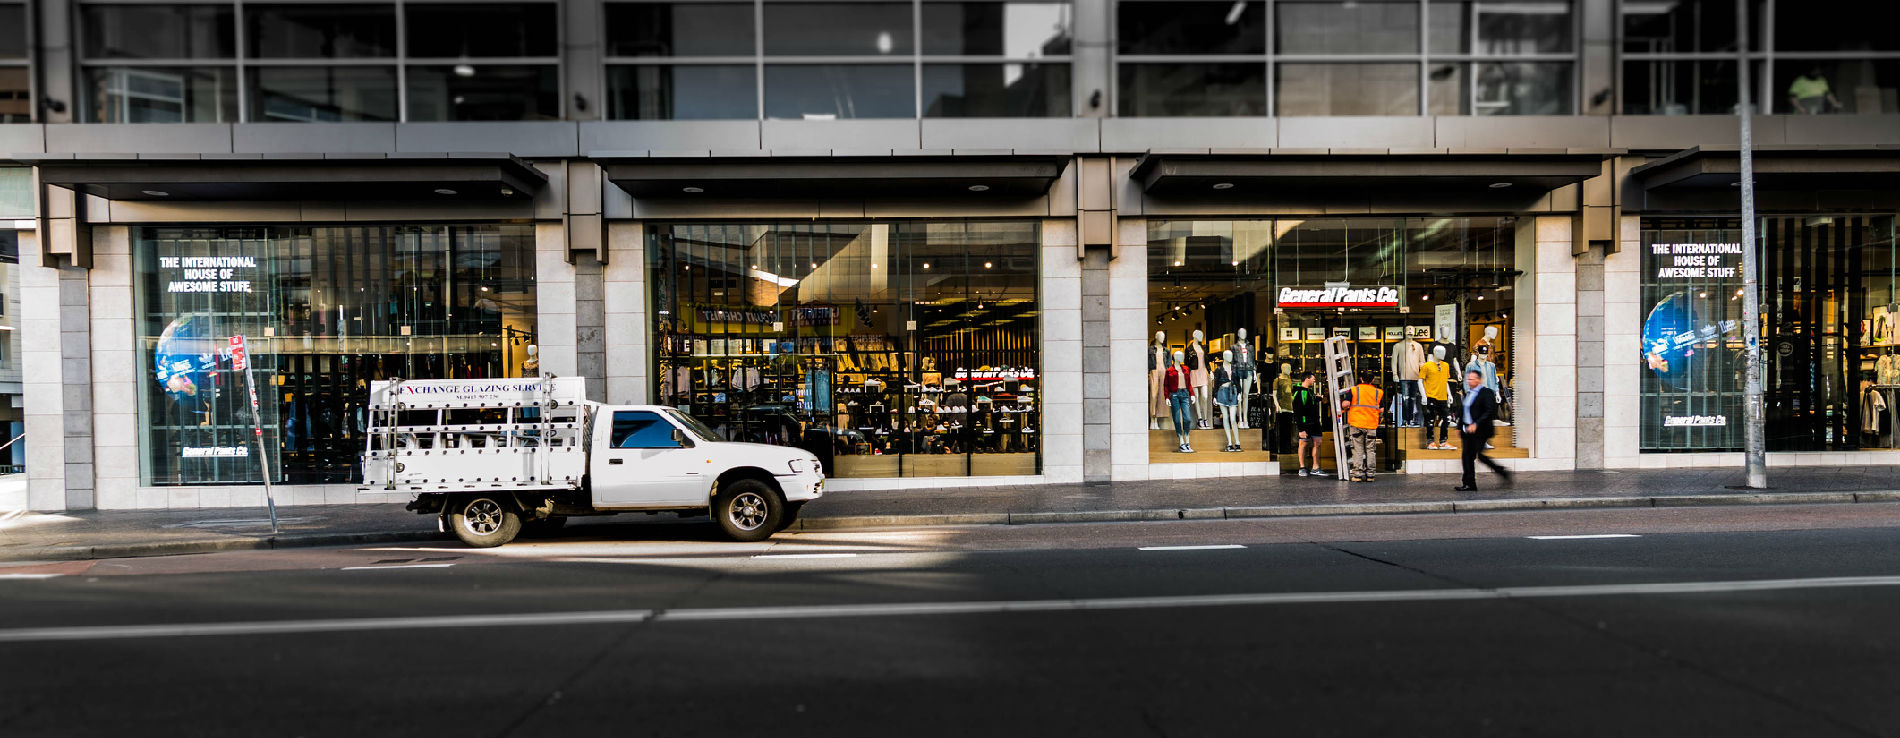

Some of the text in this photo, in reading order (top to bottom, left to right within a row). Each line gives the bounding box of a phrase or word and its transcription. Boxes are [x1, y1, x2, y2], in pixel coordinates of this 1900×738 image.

[1652, 243, 1742, 254] THE INTERNATIONAL
[160, 256, 256, 268] THE INTERNATIONAL
[1674, 255, 1720, 266] HOUSE OF
[184, 268, 233, 280] HOUSE OF
[1658, 267, 1735, 277] AWESOME STUFF
[168, 281, 218, 292] AWESOME
[1279, 287, 1398, 302] General Pants Co.
[1413, 328, 1428, 337] Lee
[399, 383, 557, 395] EXCHANGE GLAZING SERVIE
